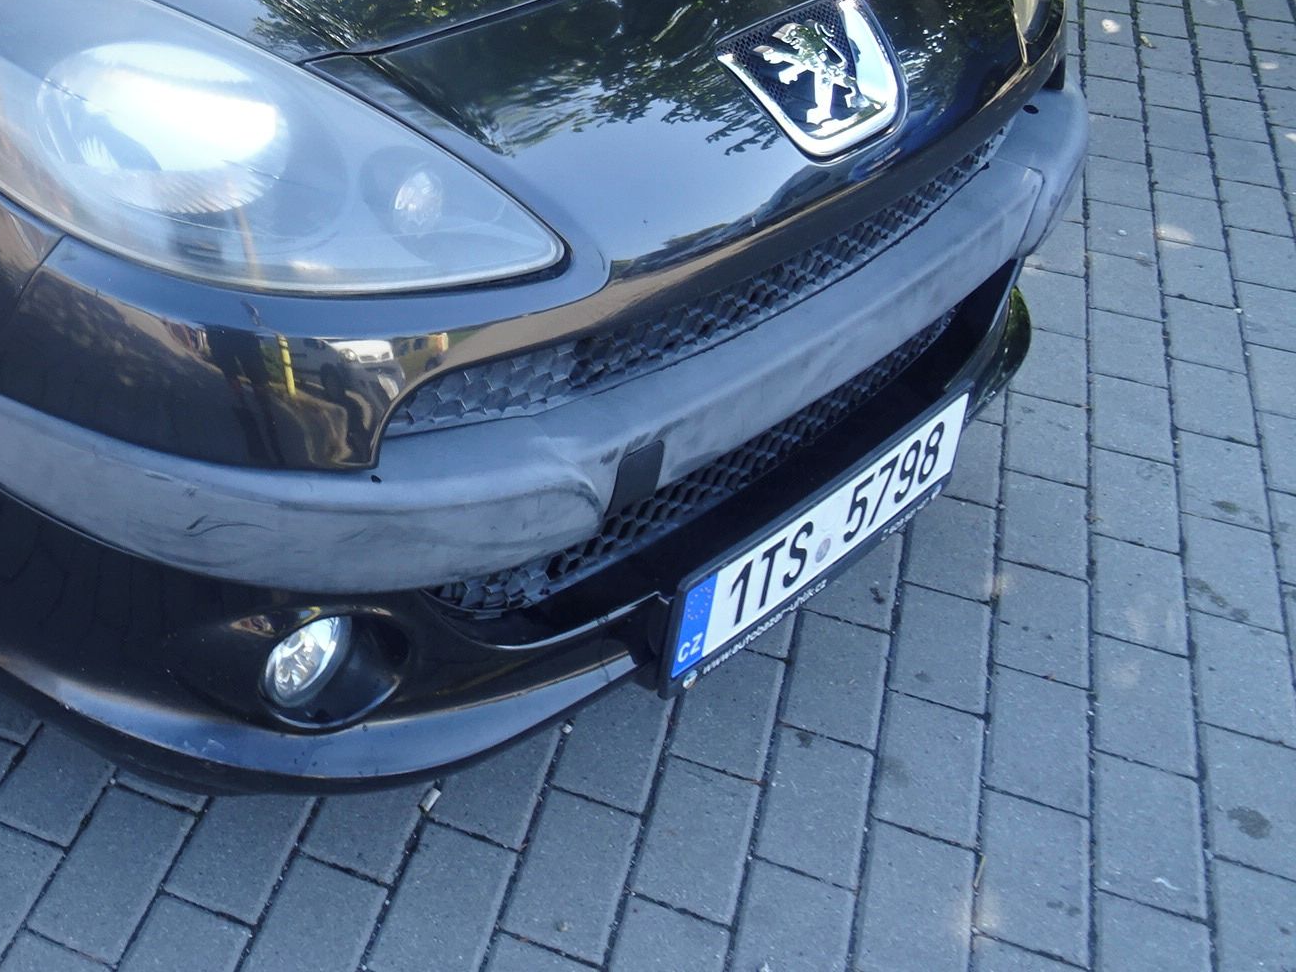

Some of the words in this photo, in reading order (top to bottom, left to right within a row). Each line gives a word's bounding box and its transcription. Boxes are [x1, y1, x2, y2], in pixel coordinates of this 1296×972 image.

[729, 520, 814, 627] 1TS
[843, 420, 946, 543] 5798
[677, 632, 704, 663] CZ
